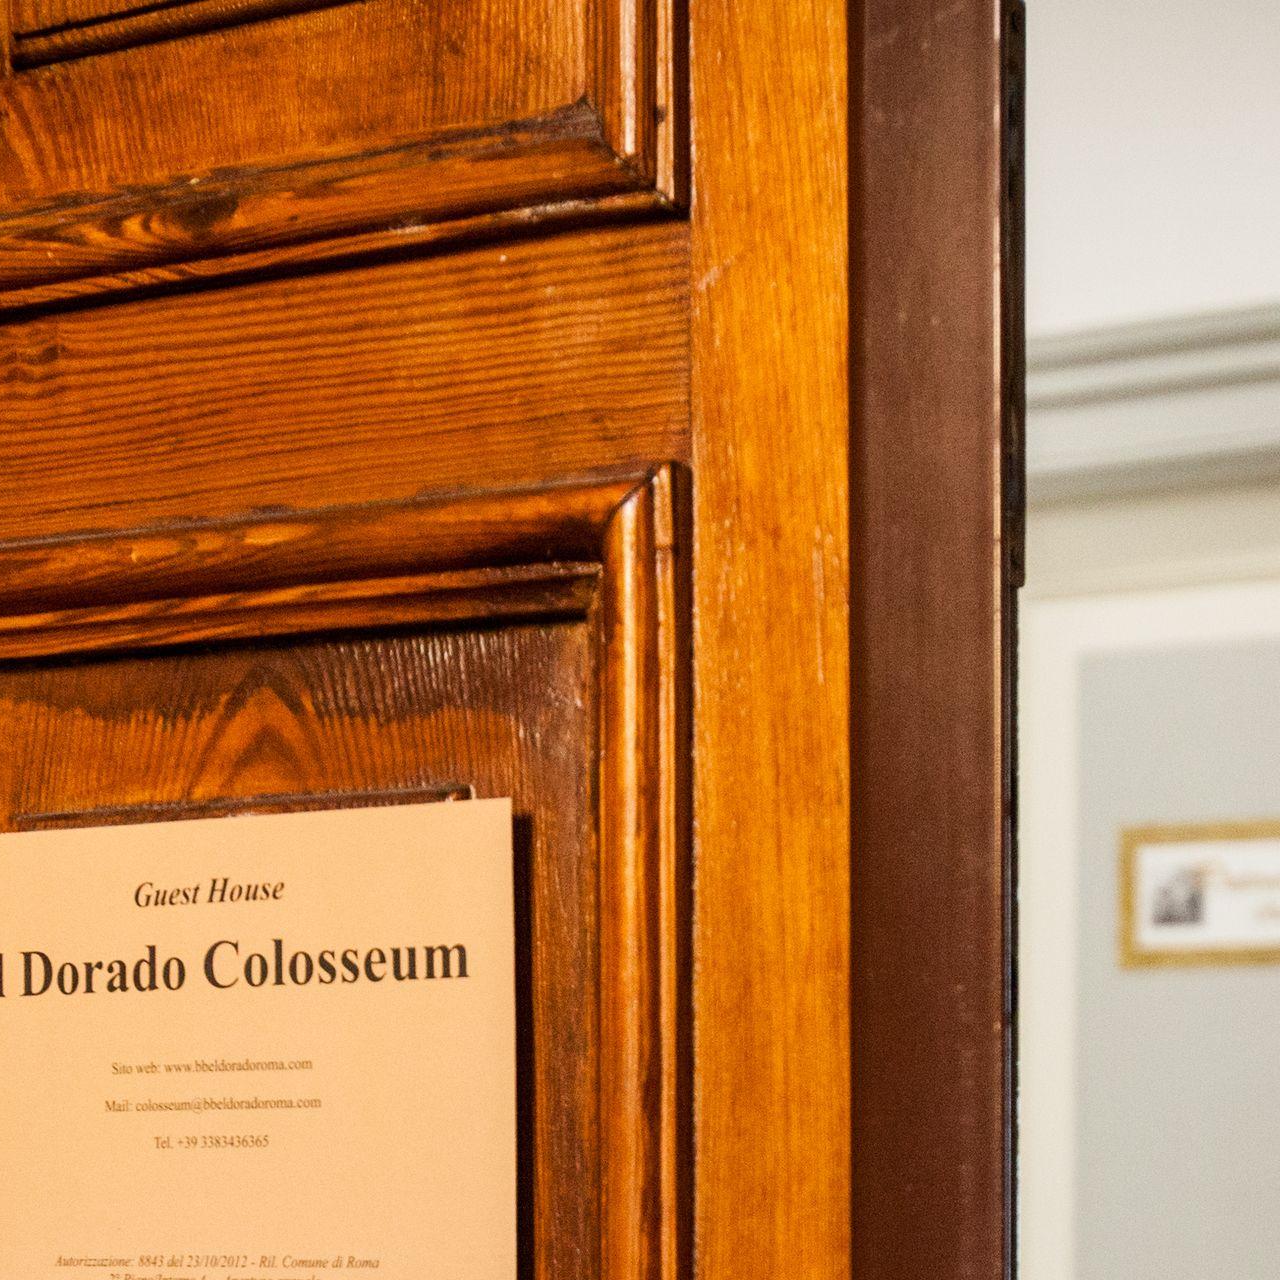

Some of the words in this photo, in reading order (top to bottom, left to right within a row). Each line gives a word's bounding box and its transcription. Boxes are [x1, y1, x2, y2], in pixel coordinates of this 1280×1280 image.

[133, 881, 200, 908] Guest
[207, 877, 285, 904] House
[20, 944, 187, 997] Dorado
[203, 938, 470, 989] Colosseum
[111, 1061, 133, 1075] Sito
[135, 1060, 161, 1075] web:
[164, 1058, 313, 1074] www.bbeldoradoroma.com
[105, 1099, 131, 1113] Mail:
[135, 1096, 322, 1114] colosseum@bbeldoradoroma.com
[154, 1136, 174, 1150] Tel.
[177, 1136, 199, 1150] +39
[166, 1254, 184, 1268] del
[281, 1254, 329, 1269] Comune
[331, 1255, 343, 1269] di
[345, 1255, 380, 1269] Roma
